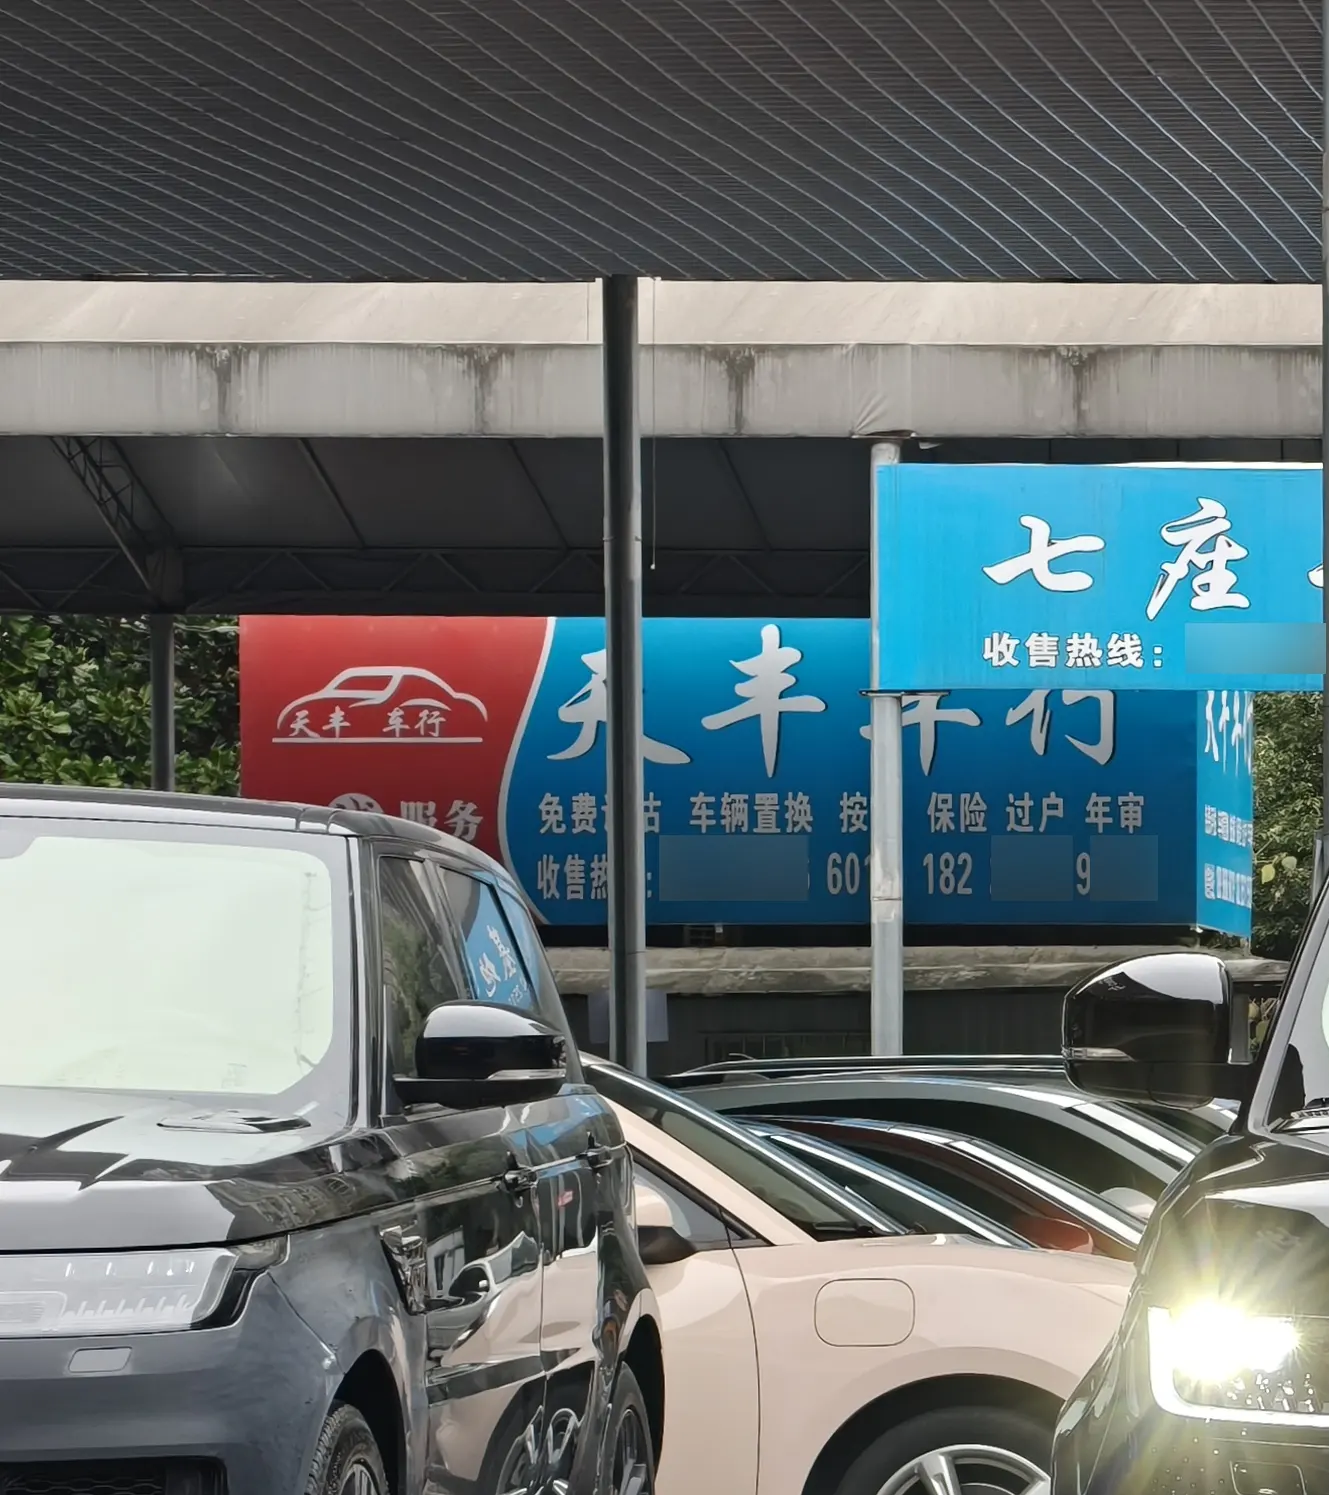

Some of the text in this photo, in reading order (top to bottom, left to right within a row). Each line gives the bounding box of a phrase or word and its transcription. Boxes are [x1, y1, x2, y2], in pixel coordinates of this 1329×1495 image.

[689, 792, 814, 834] 车辆置换
[927, 792, 988, 833] 保险
[1006, 792, 1064, 833] 过户
[1085, 792, 1144, 834] 年审
